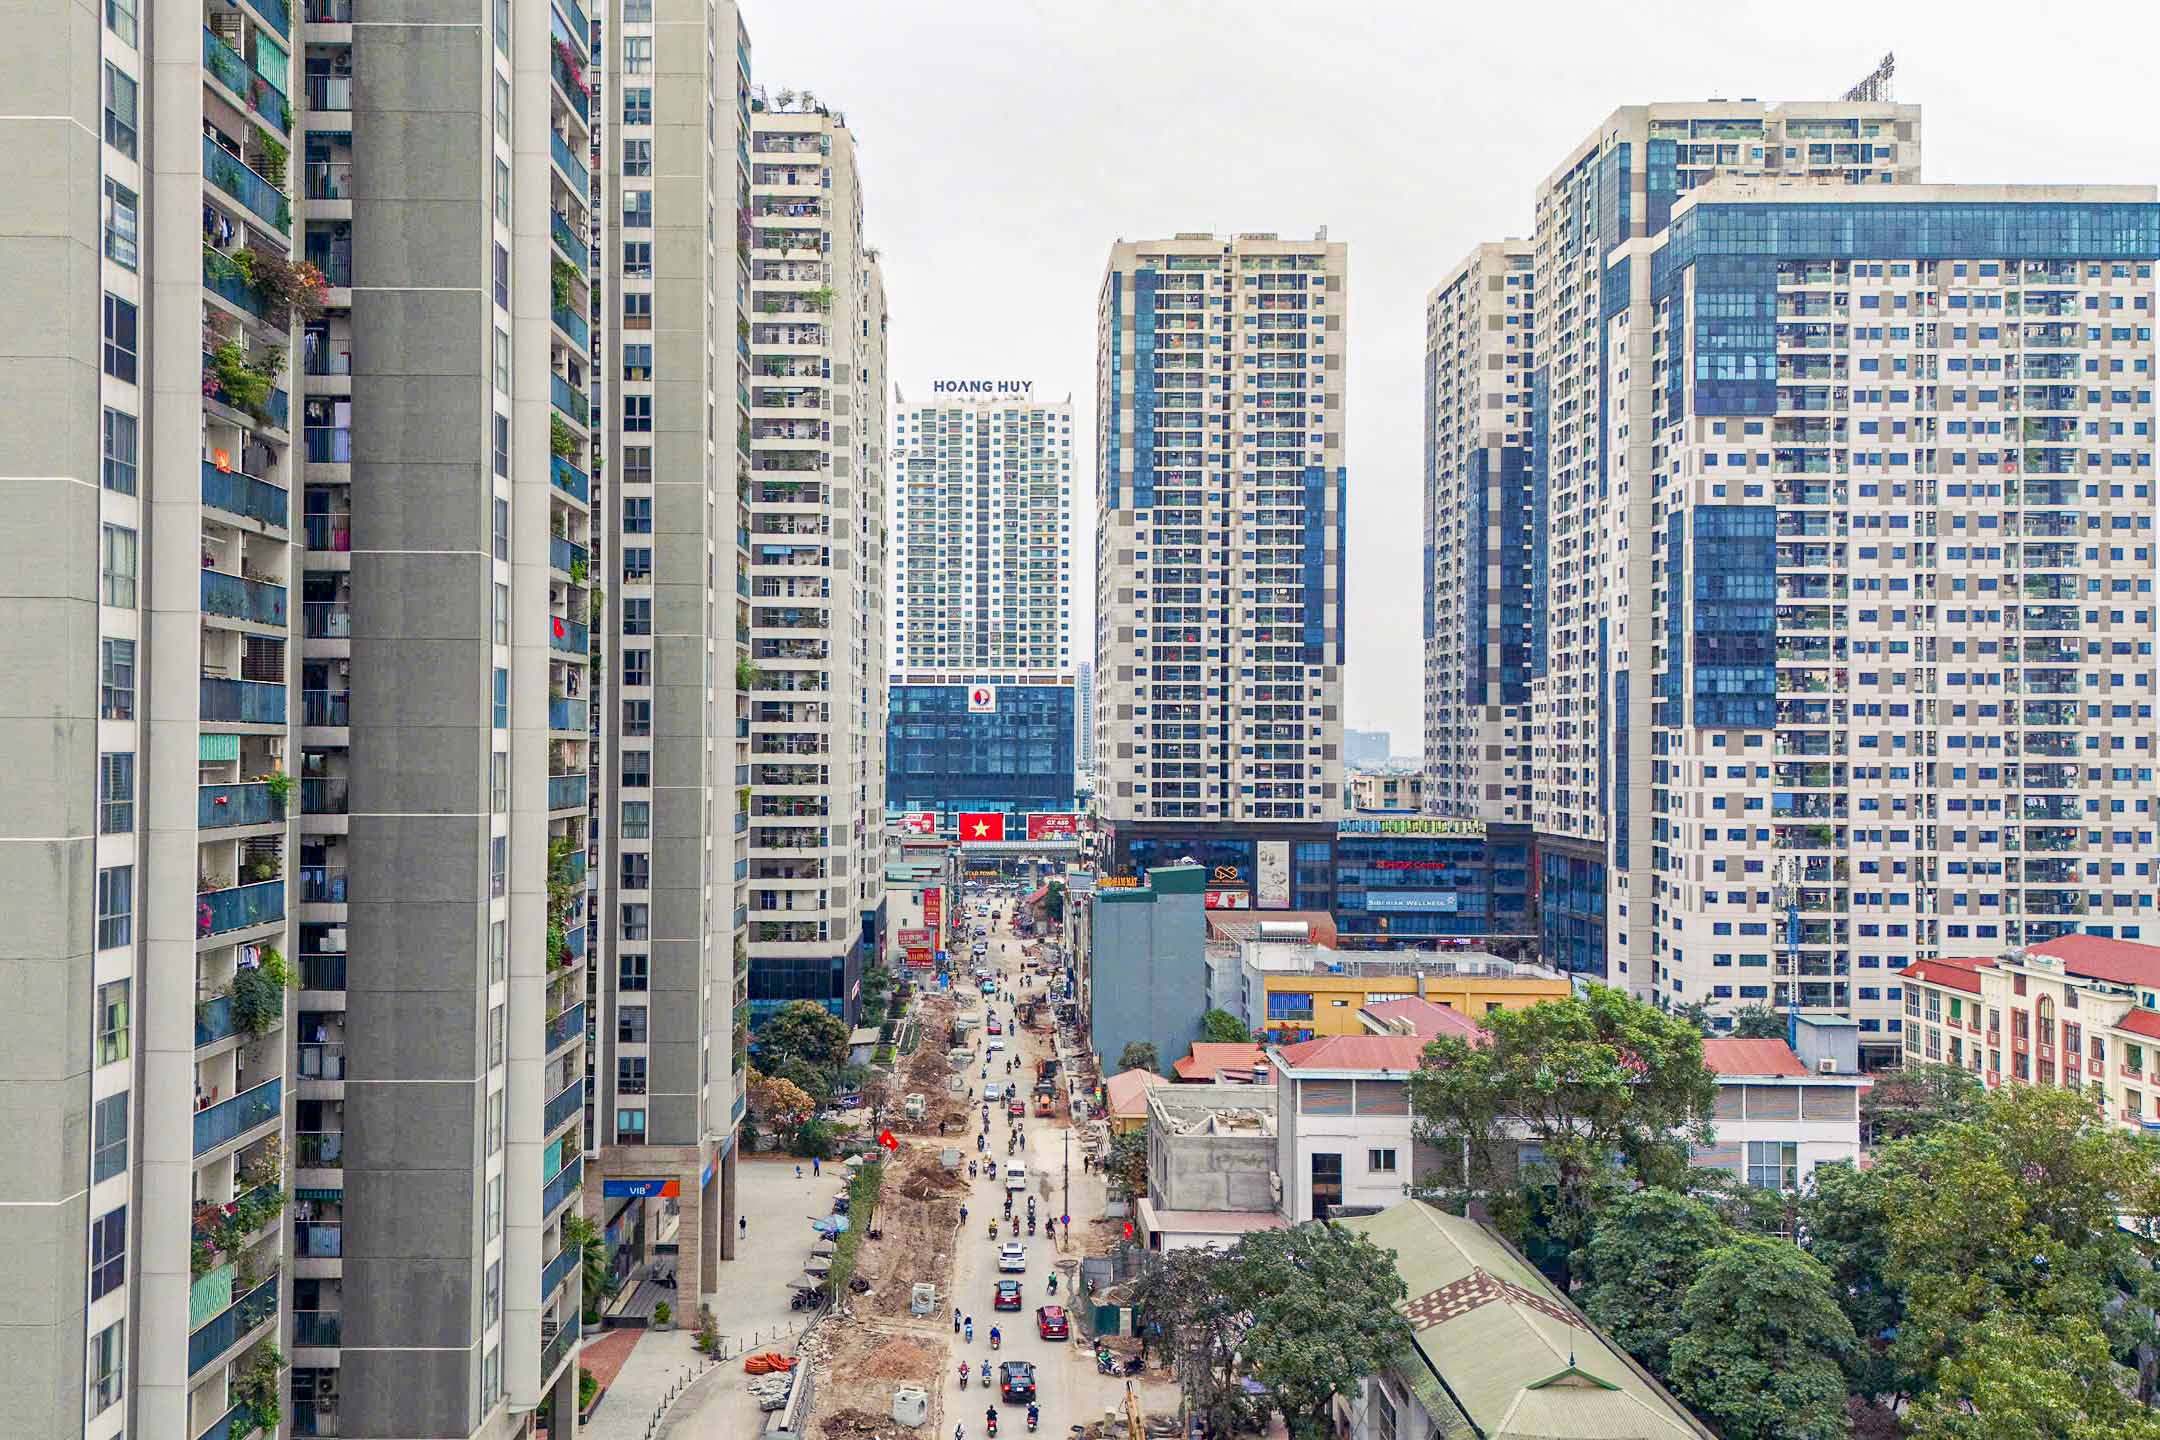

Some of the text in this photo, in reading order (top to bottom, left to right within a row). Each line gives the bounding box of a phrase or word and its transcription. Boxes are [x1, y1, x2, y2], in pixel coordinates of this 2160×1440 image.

[934, 380, 1032, 392] HOANG HUY
[629, 1187, 646, 1196] VIB
